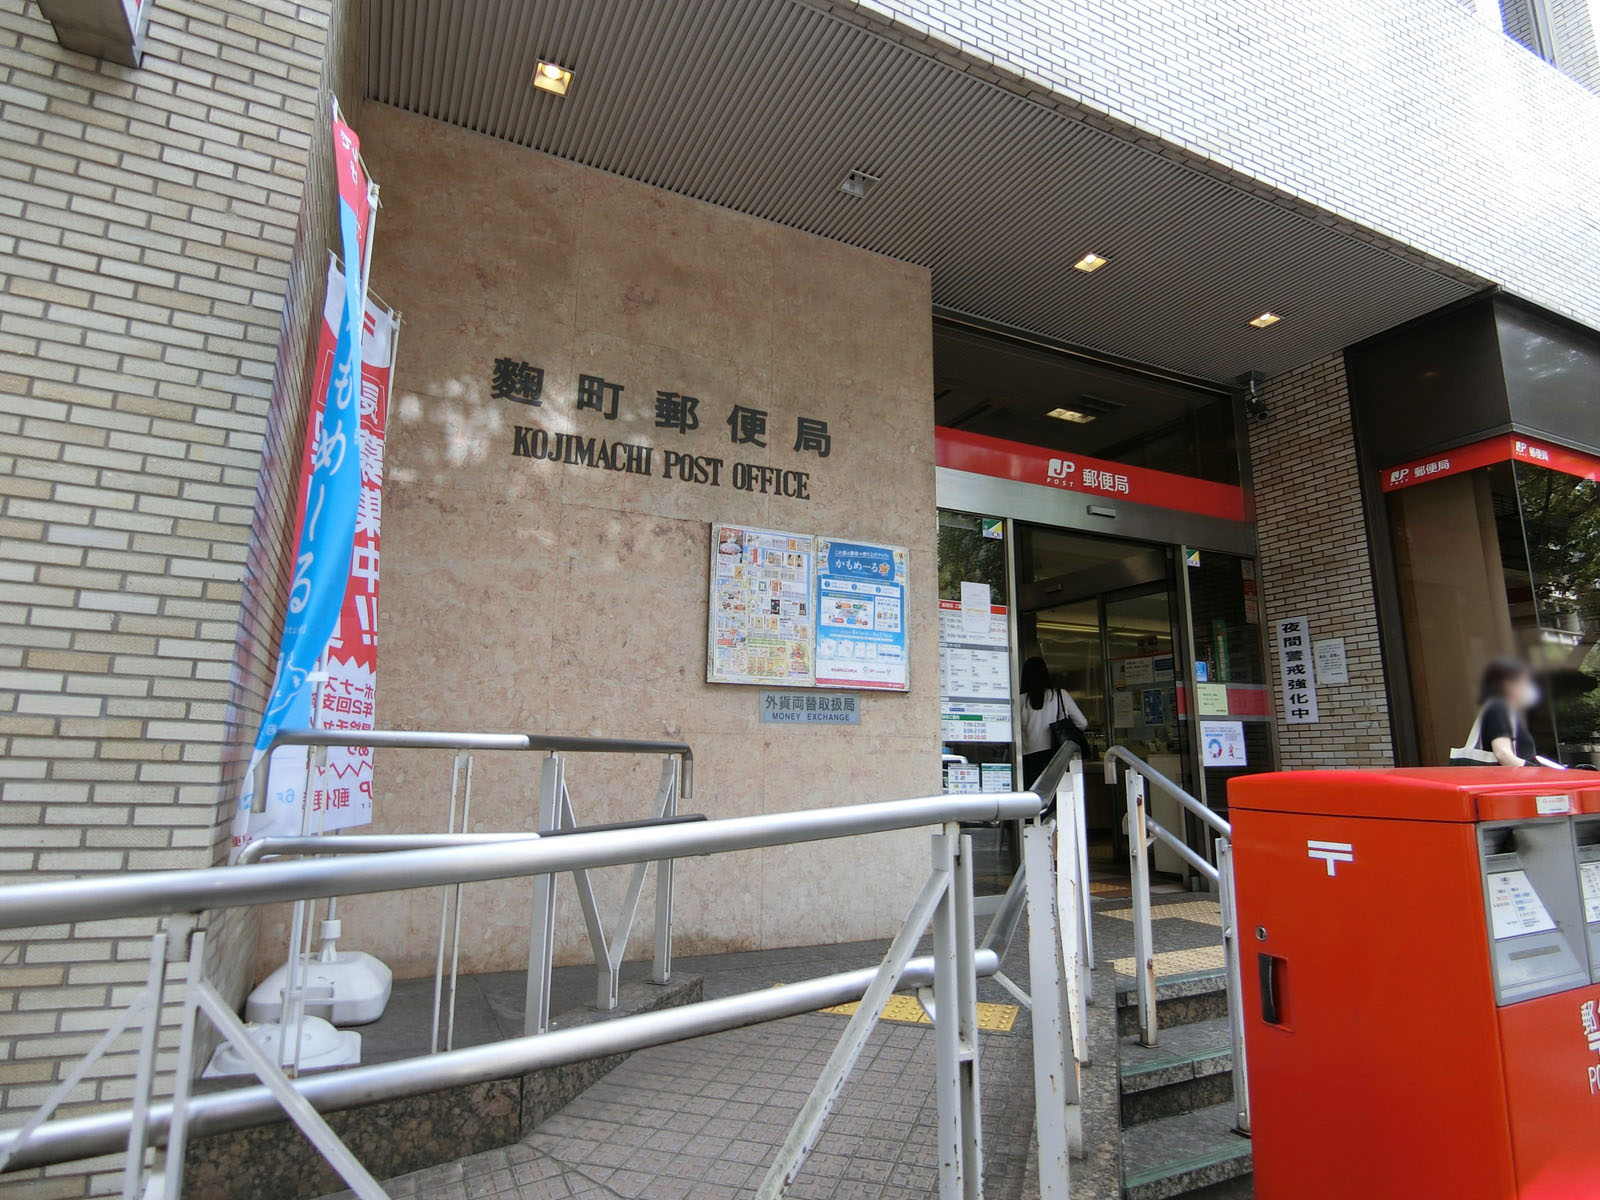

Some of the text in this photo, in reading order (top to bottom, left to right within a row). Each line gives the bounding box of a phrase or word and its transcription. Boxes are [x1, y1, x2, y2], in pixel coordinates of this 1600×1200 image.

[512, 426, 810, 500] KOJIMACHI POST OFFICE
[1413, 459, 1450, 478] 郵便局
[290, 345, 353, 614] もめーる
[1046, 477, 1074, 487] POST
[1083, 468, 1129, 494] 郵便局
[835, 559, 879, 573] かもめーる
[1281, 622, 1309, 719] 夜間警戒強化中
[765, 694, 855, 712] 外貨両替取扱局
[772, 712, 849, 721] MONEY EXCHANGE
[1581, 1000, 1600, 1036] 郵
